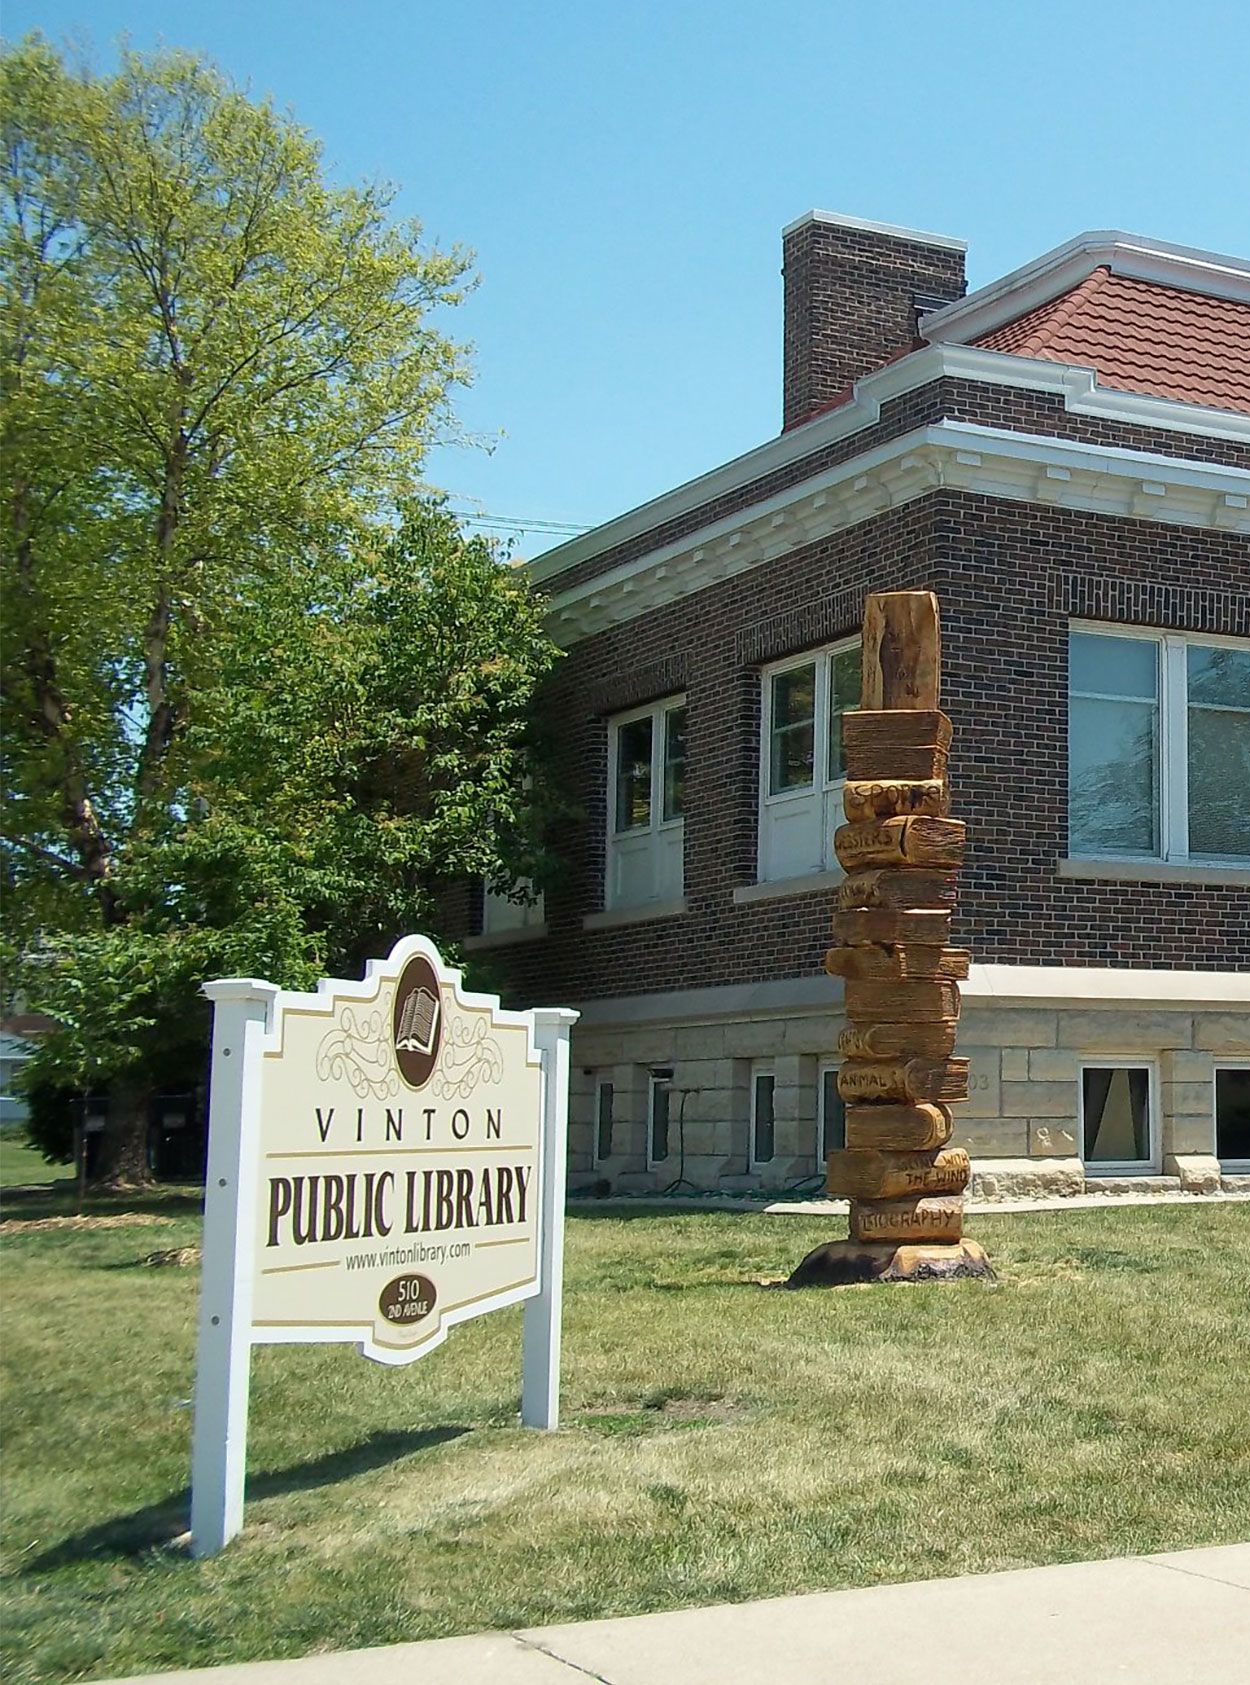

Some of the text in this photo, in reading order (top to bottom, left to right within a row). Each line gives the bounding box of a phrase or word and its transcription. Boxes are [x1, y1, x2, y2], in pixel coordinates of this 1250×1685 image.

[315, 1107, 502, 1143] VINTON
[941, 1152, 970, 1167] WITH
[905, 1168, 968, 1187] THE WIND
[265, 1165, 532, 1248] PUBLIC LIBRARY
[345, 1240, 471, 1271] www.vintonlibrary.com
[397, 1279, 420, 1302] 510
[402, 1300, 428, 1317] AVENUE
